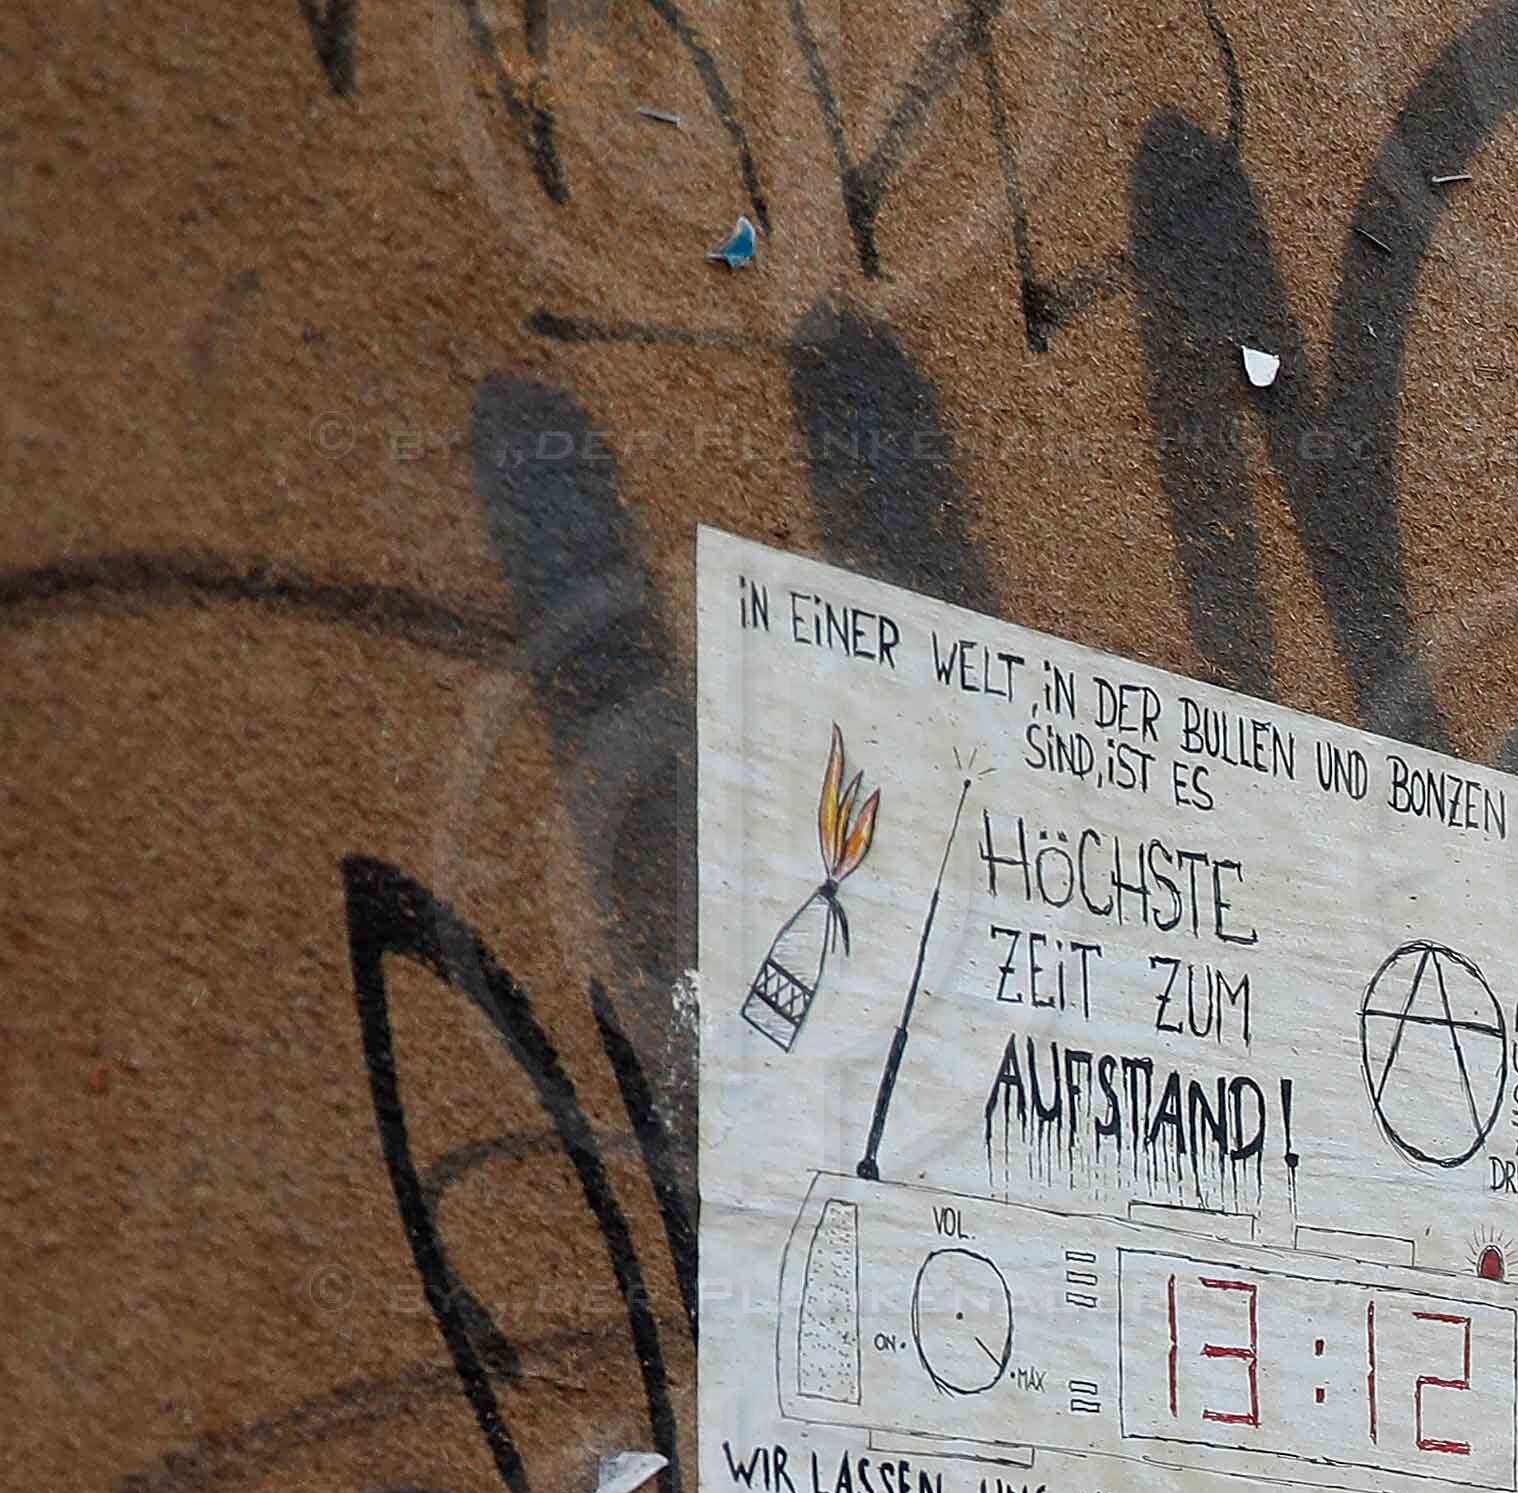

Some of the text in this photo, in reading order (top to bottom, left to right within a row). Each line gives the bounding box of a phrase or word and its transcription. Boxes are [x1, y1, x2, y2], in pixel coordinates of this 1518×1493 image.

[1093, 677, 1161, 741] DER
[1179, 697, 1295, 780] BULLEN
[1316, 741, 1368, 800] UND
[1386, 755, 1506, 840] BONZEN
[1174, 760, 1214, 810] ES
[980, 809, 1258, 944] HÖCHSTE
[1150, 957, 1250, 1047] ZUM
[985, 1033, 1299, 1172] AUFSTAND!
[933, 1207, 976, 1241] VOL.
